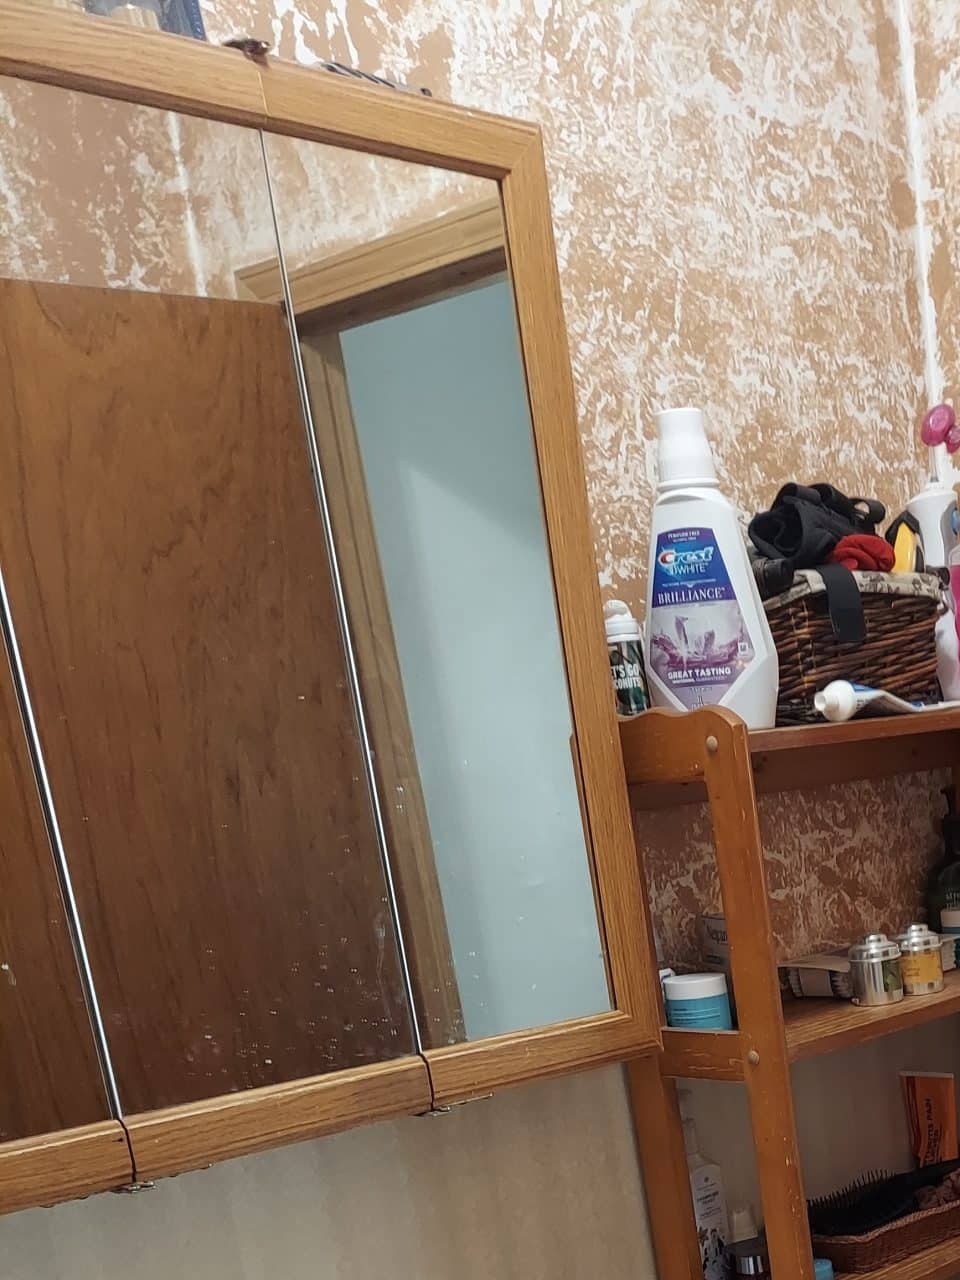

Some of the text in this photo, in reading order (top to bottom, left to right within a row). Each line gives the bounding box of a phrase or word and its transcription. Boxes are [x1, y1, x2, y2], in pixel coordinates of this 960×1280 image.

[658, 546, 714, 567] Crest
[657, 587, 722, 604] BRILLIANCE
[667, 666, 732, 680] GREAT TASTING
